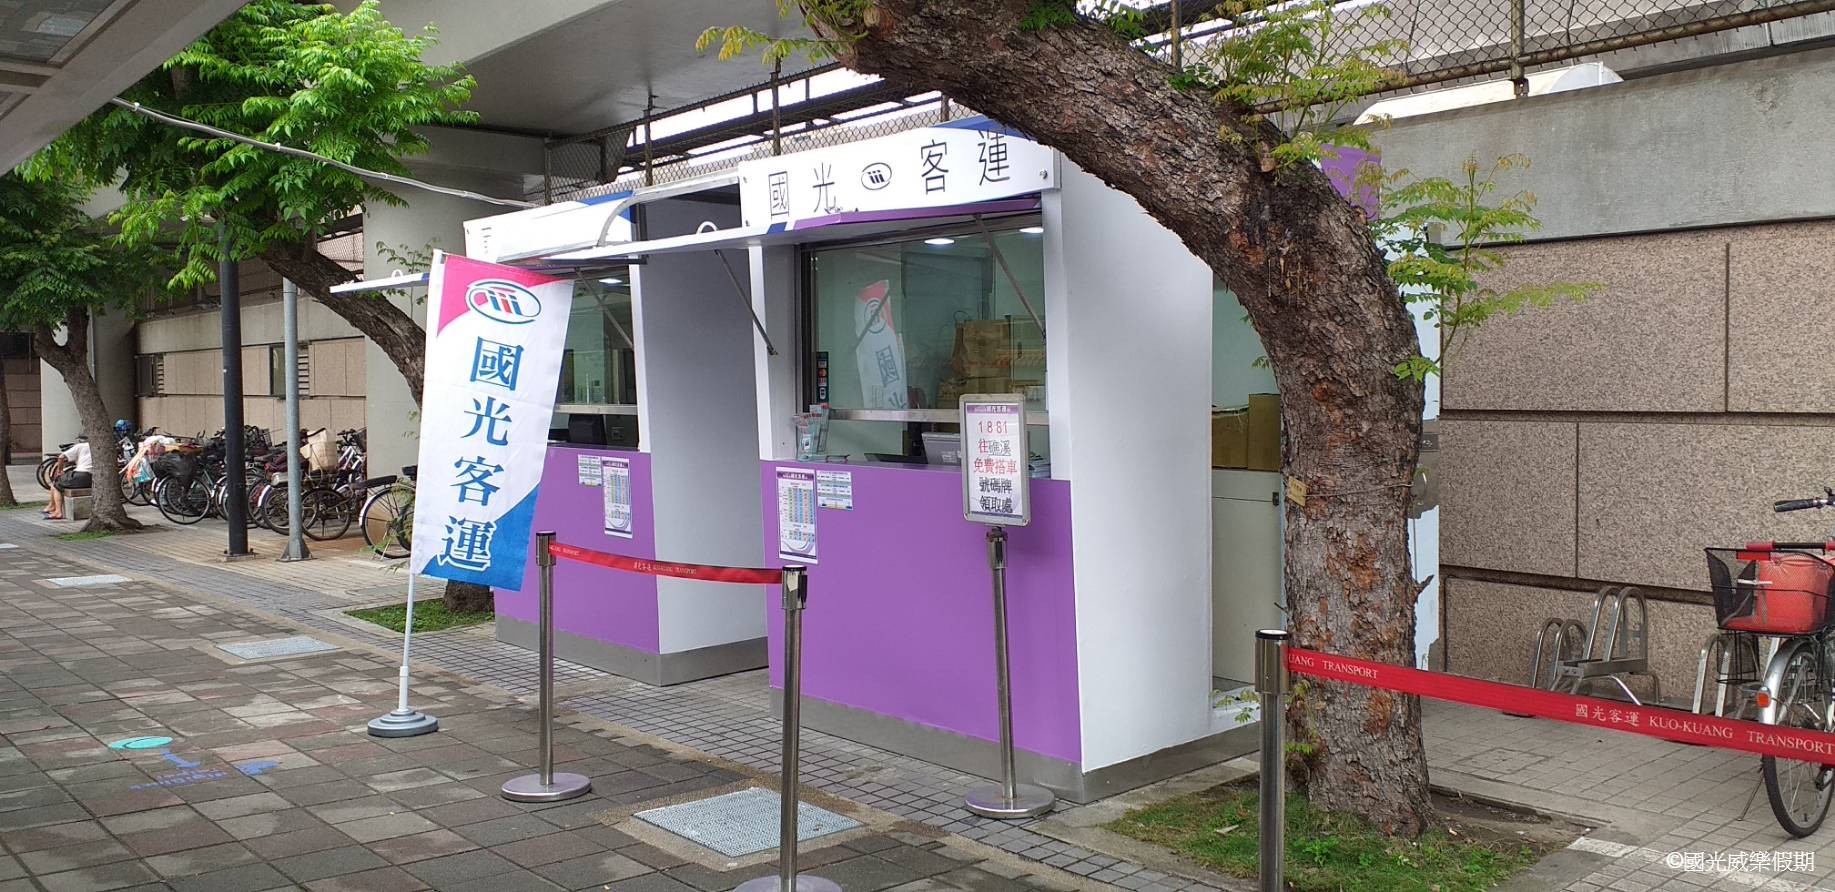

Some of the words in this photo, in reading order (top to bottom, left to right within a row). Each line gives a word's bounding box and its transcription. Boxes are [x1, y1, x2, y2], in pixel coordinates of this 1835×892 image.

[768, 161, 837, 217] 國光
[920, 128, 1011, 195] 客運
[438, 335, 524, 571] 國光客運
[973, 457, 1017, 475] 免費搭車
[979, 476, 1013, 494] 號碼牌
[980, 495, 1013, 513] 領取處
[1322, 659, 1379, 680] TRANSPORT
[1575, 703, 1640, 727] 國光客運
[1650, 715, 1734, 739] KUO-KUANG
[1747, 730, 1835, 755] TRANSPORT
